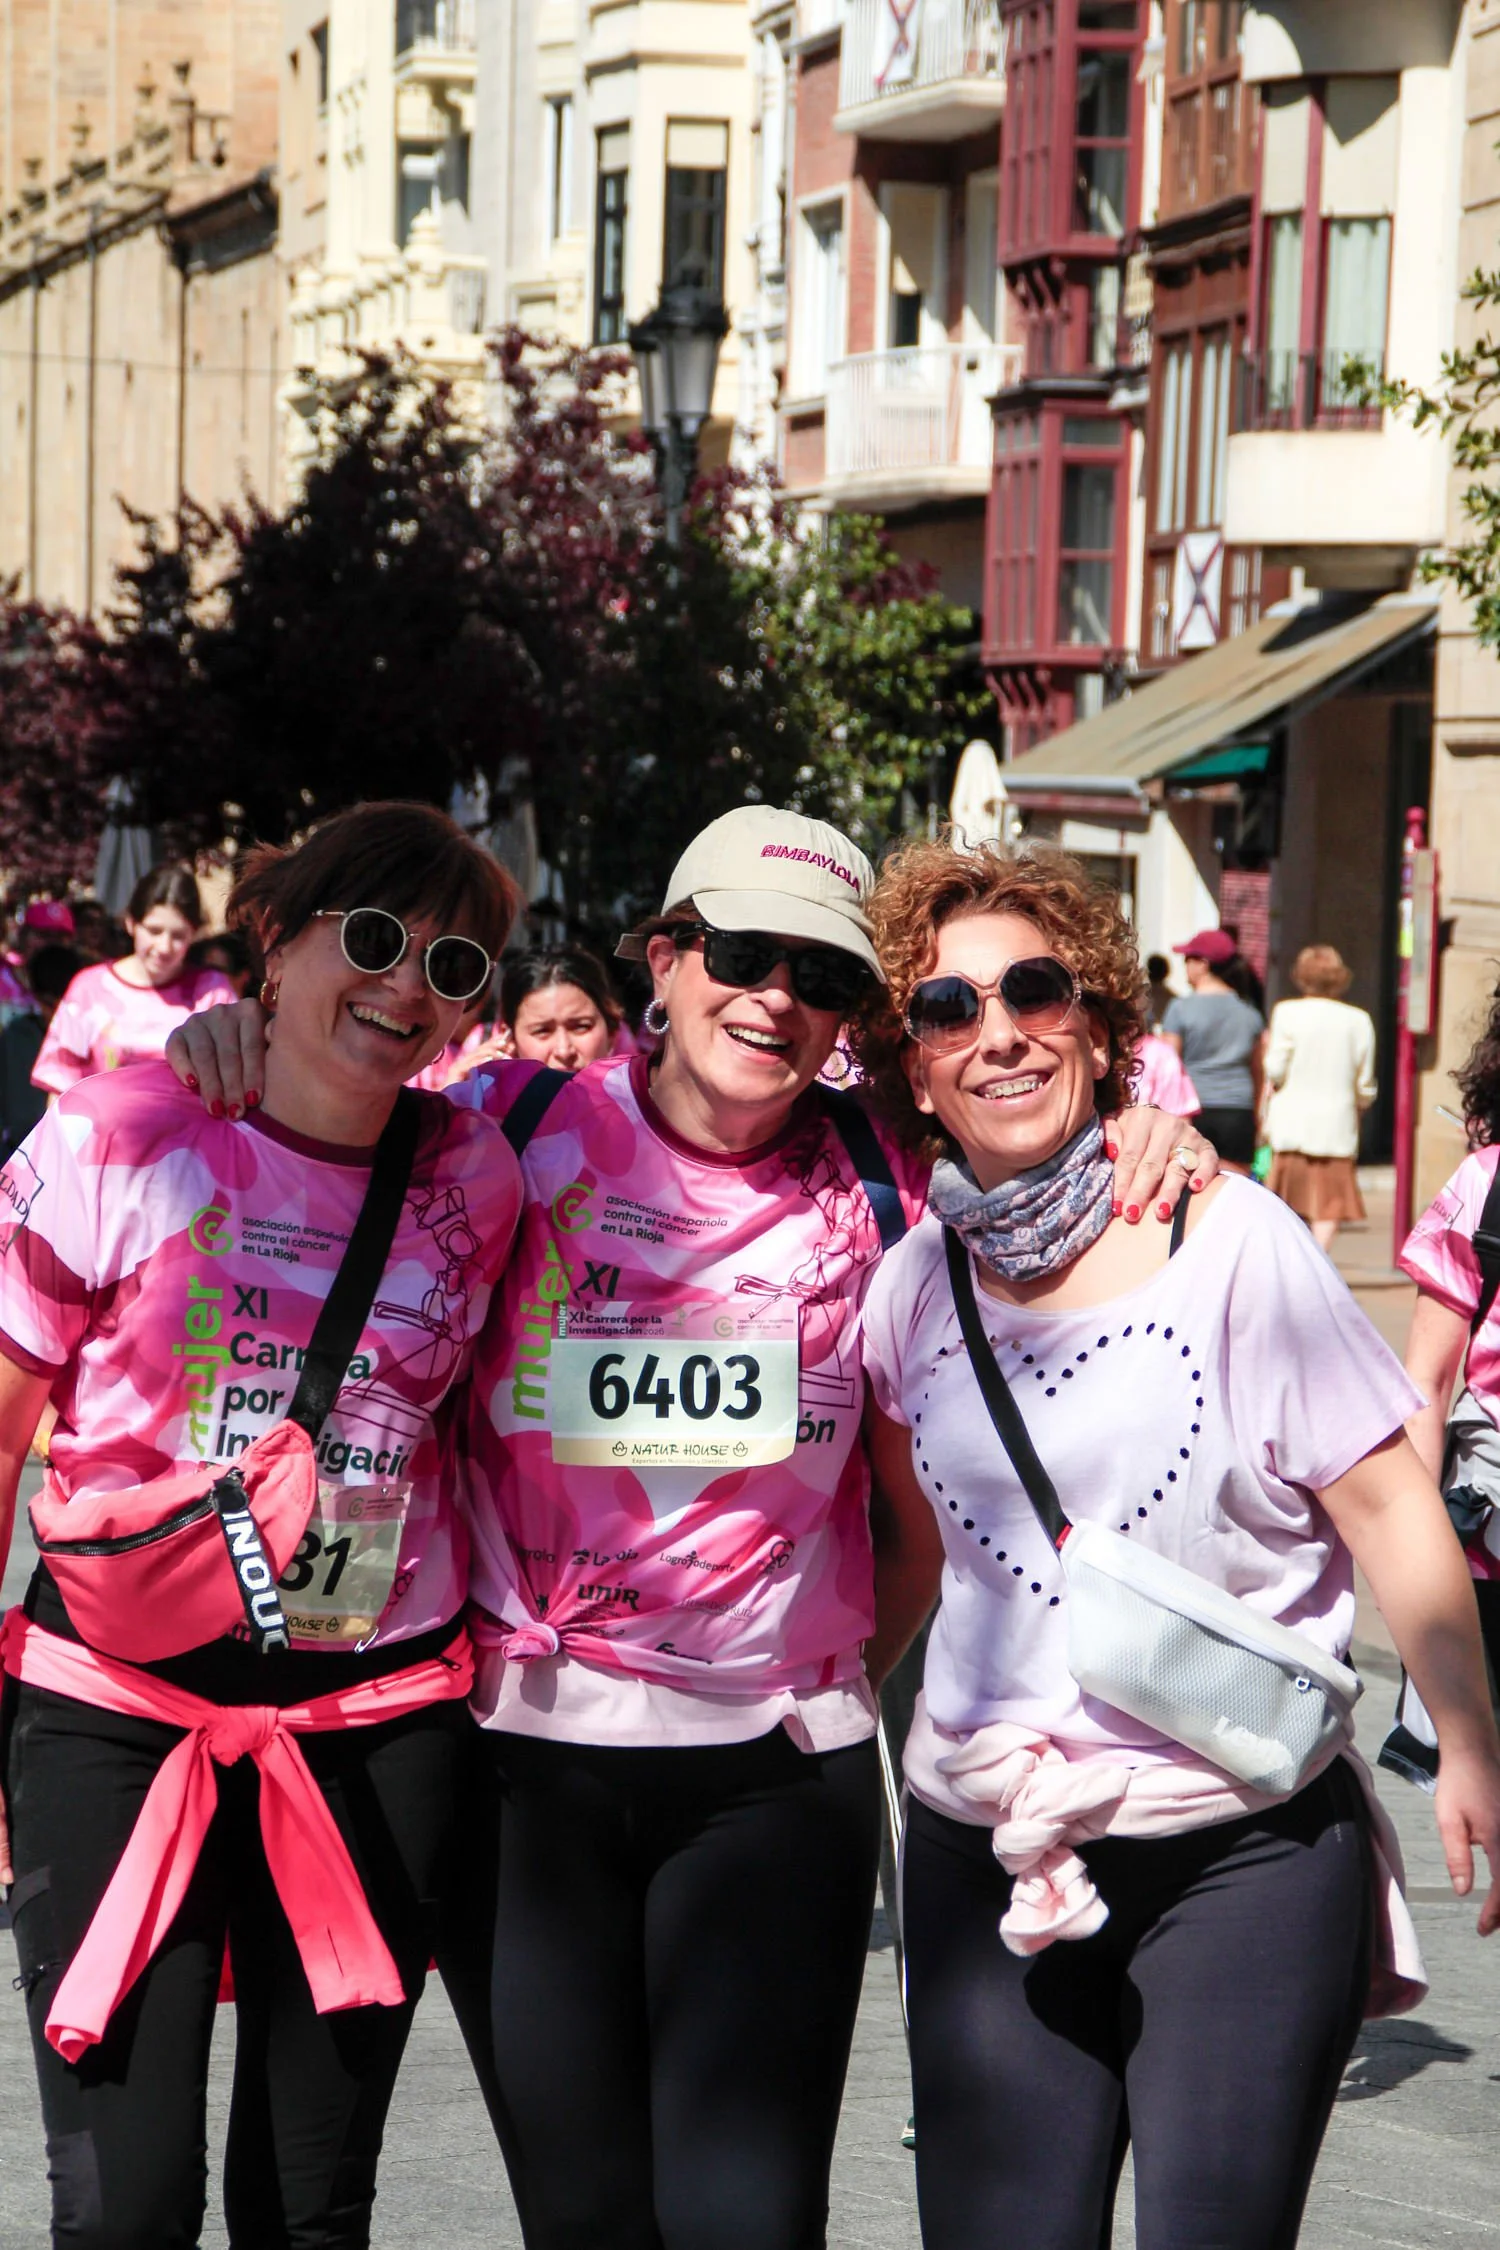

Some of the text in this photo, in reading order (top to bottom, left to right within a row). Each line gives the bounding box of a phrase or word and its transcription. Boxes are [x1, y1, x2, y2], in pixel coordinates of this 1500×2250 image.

[760, 844, 860, 893] BIMBAYLOLA
[242, 1217, 301, 1234] asociación
[603, 1208, 701, 1236] contra el cáncer
[605, 1195, 728, 1229] asociación española
[241, 1230, 331, 1252] contra el cáncer
[600, 1223, 665, 1244] en La Rioja
[241, 1244, 300, 1263] en La Rioja
[574, 1260, 621, 1298] XI
[232, 1284, 268, 1320] XI
[569, 1311, 662, 1326] XI Carrera por la
[557, 1303, 568, 1338] mujer
[173, 1276, 231, 1456] mujer
[221, 1385, 285, 1420] por
[589, 1353, 762, 1420] 6403
[631, 1443, 729, 1457] NATUR HOUSE
